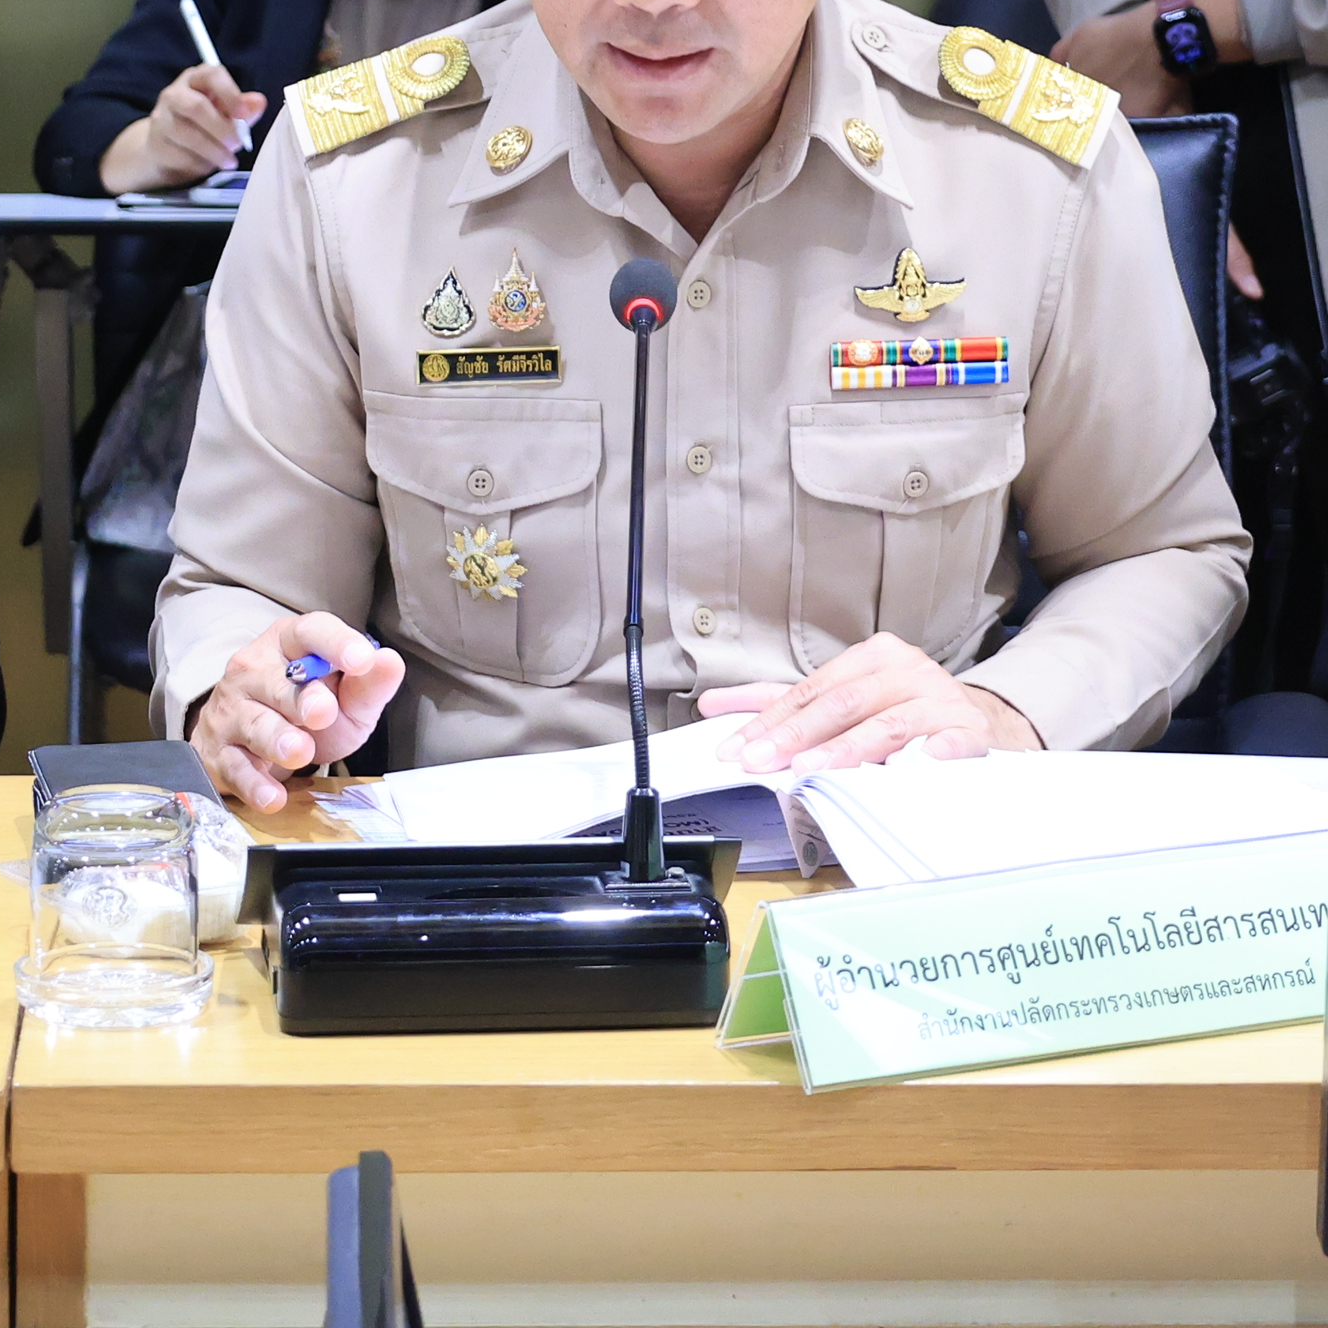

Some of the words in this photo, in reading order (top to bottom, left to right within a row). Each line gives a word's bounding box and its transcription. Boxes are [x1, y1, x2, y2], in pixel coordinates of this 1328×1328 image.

[917, 957, 1317, 1040] สำนักงานปลัดกระทรวงเกษตรและสหกรณ์
